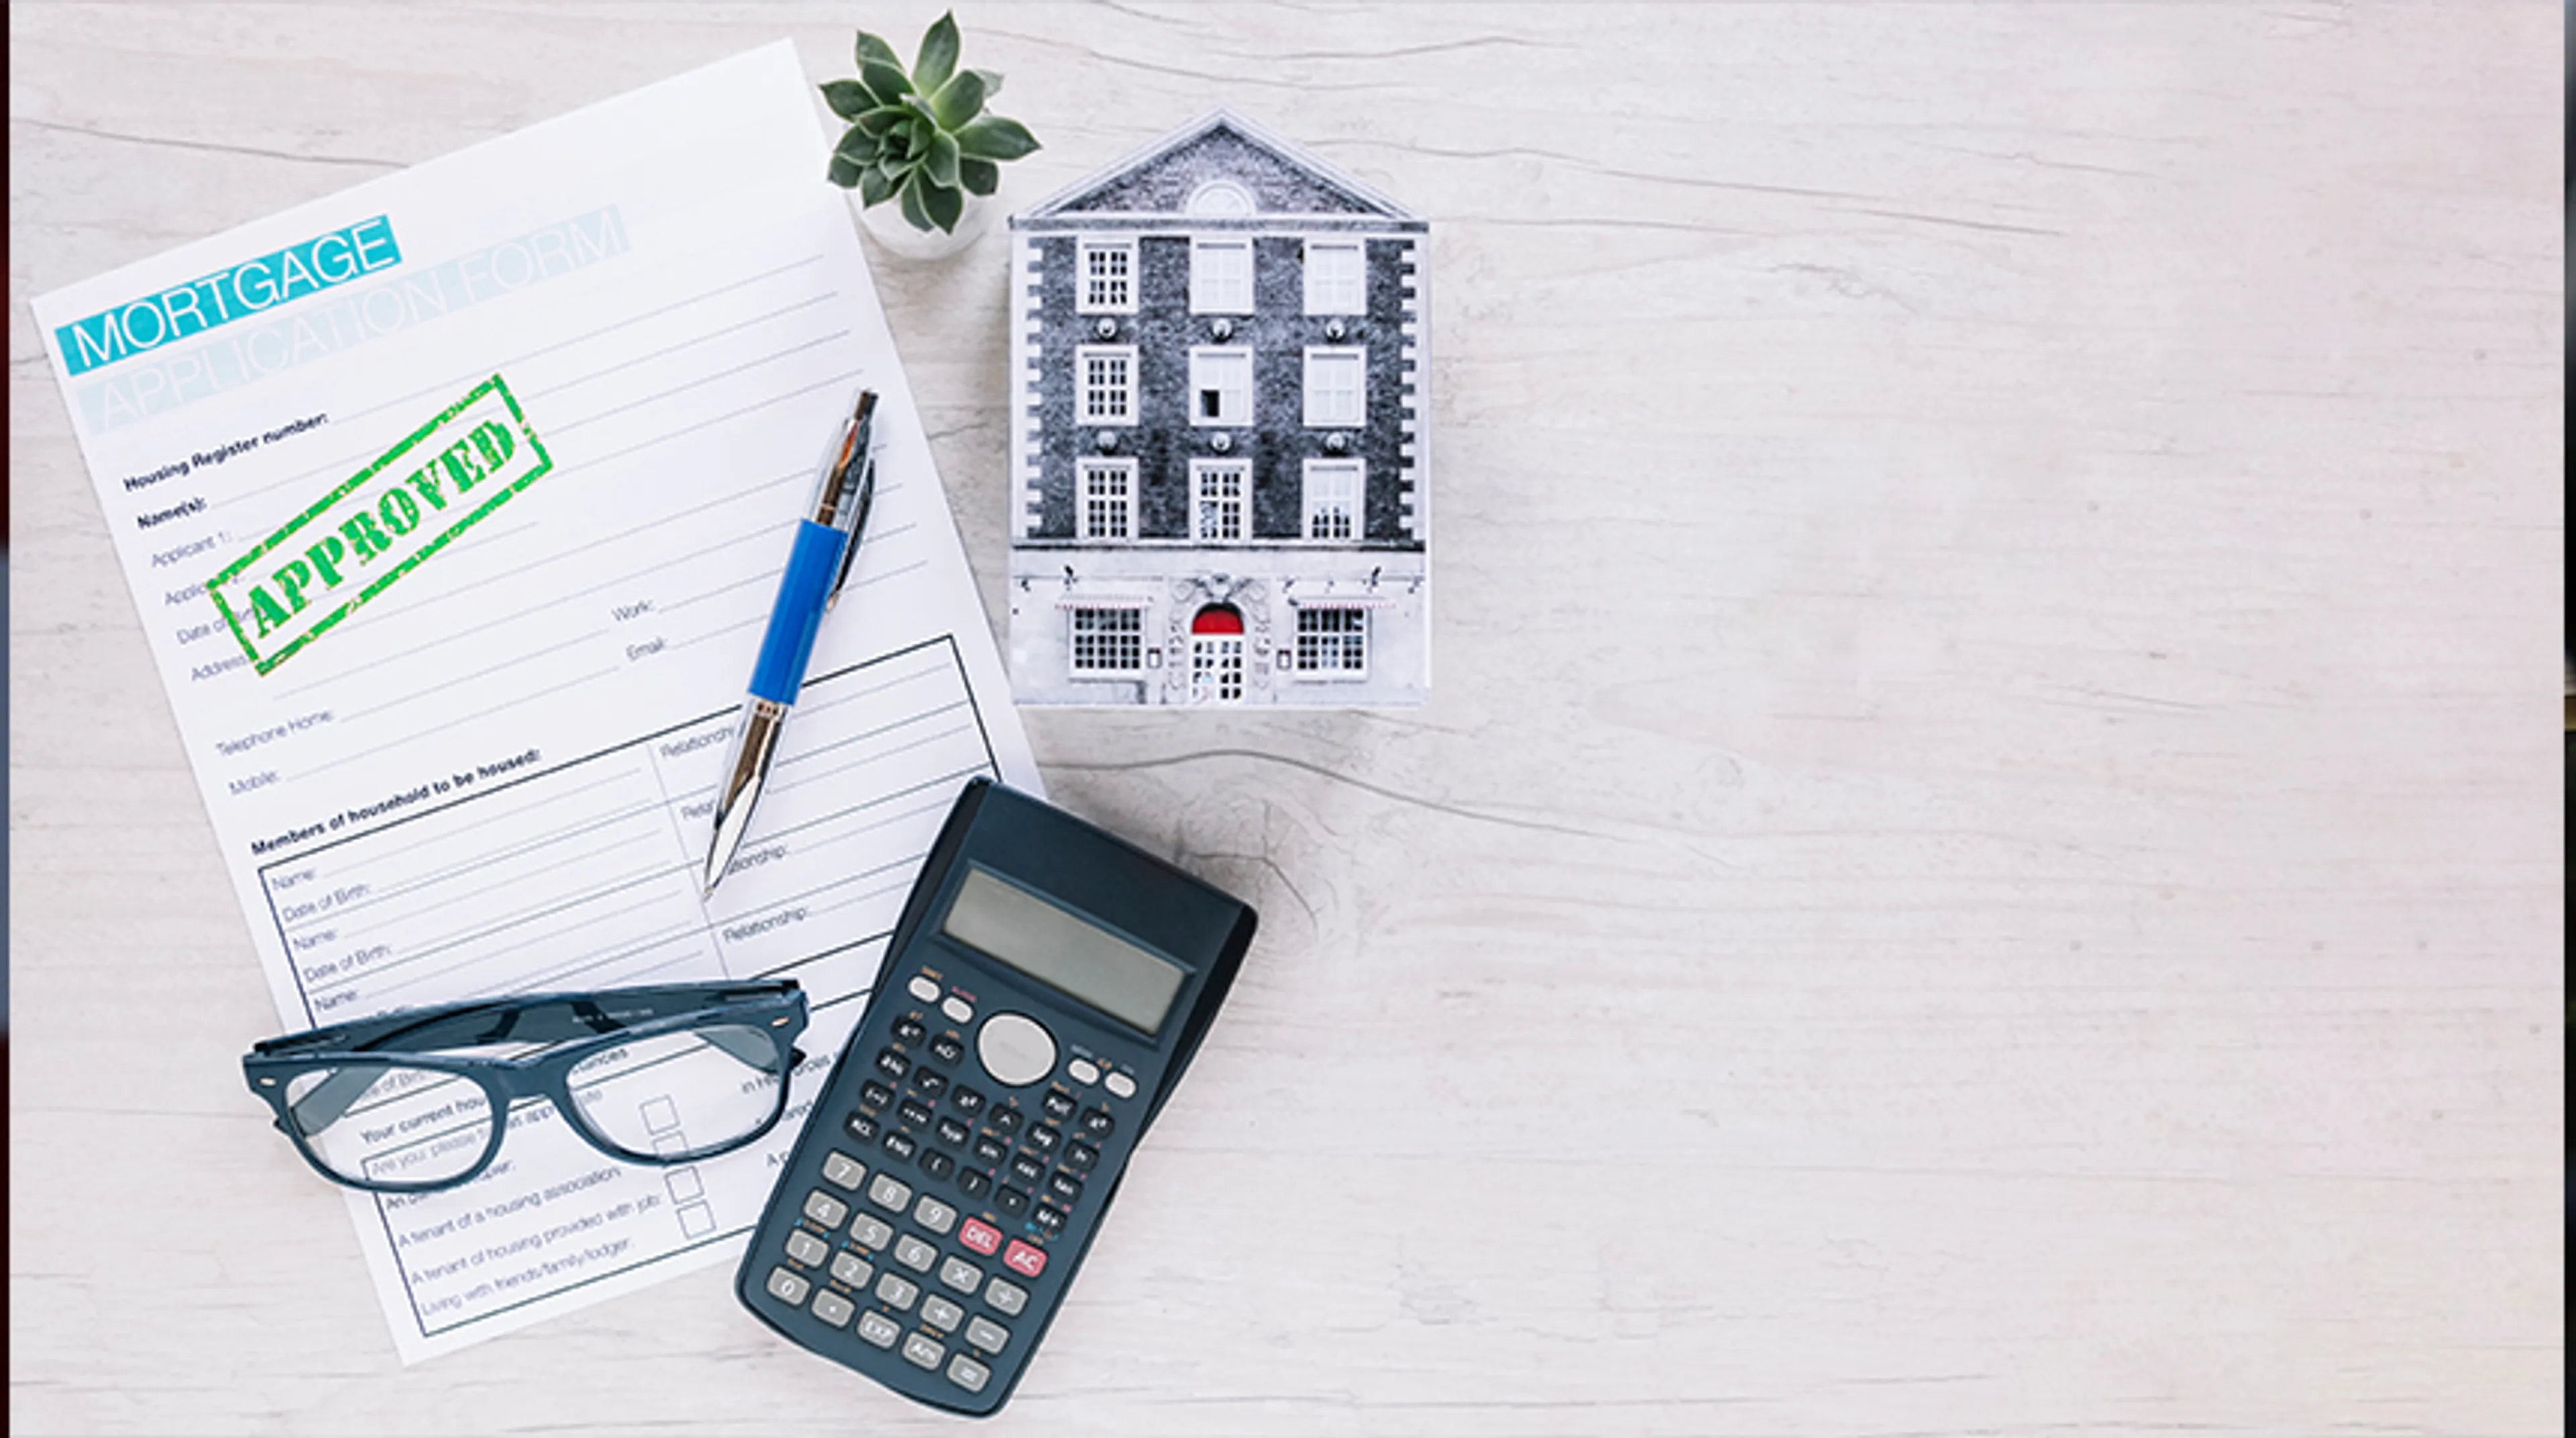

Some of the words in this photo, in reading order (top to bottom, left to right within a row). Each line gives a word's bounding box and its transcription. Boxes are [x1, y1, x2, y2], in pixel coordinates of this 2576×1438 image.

[70, 217, 396, 368] MORTGAGE
[101, 270, 448, 430] APPLICATION
[458, 212, 623, 304] FORM
[123, 460, 190, 492] Housing
[191, 436, 258, 467] Register
[262, 413, 329, 444] number:
[152, 535, 216, 568] Applicant
[610, 599, 655, 623] Work:
[176, 623, 211, 645] Date
[215, 724, 287, 757] Telephone
[227, 769, 281, 797] Mobile:
[250, 823, 326, 856] Members
[329, 813, 346, 831] of
[347, 785, 431, 825] household
[432, 780, 451, 797] to
[452, 770, 474, 789] be
[476, 747, 543, 780] housed:
[271, 868, 315, 890] Name:
[282, 903, 317, 923] Date
[318, 892, 333, 911] of
[722, 906, 810, 943] Relationship:
[292, 928, 338, 951] Name:
[303, 964, 338, 984] Date
[339, 954, 354, 971] of
[313, 989, 359, 1011] Name:
[359, 1123, 396, 1144] Your
[398, 1103, 455, 1133] current
[837, 1162, 851, 1178] 7
[882, 1186, 896, 1201] 8
[398, 1234, 411, 1248] A
[411, 1219, 456, 1242] tenant
[456, 1213, 473, 1229] of
[474, 1211, 486, 1224] a
[485, 1192, 542, 1218] housing
[816, 1202, 830, 1218] 4
[927, 1209, 941, 1225] 9
[411, 1272, 425, 1286] A
[424, 1257, 468, 1282] tenant
[470, 1248, 486, 1266] of
[486, 1234, 543, 1262] housing
[543, 1212, 603, 1244] provided
[604, 1200, 636, 1223] with
[863, 1225, 876, 1241] 5
[965, 1225, 992, 1248] DEL
[908, 1245, 921, 1262] 6
[1012, 1249, 1038, 1270] AC
[845, 1263, 858, 1278] 2
[420, 1292, 463, 1317] Living
[464, 1281, 496, 1302] with
[782, 1280, 796, 1296] 0
[892, 1284, 904, 1300] 3
[865, 1321, 891, 1340] EXP
[910, 1341, 936, 1362] Ans
